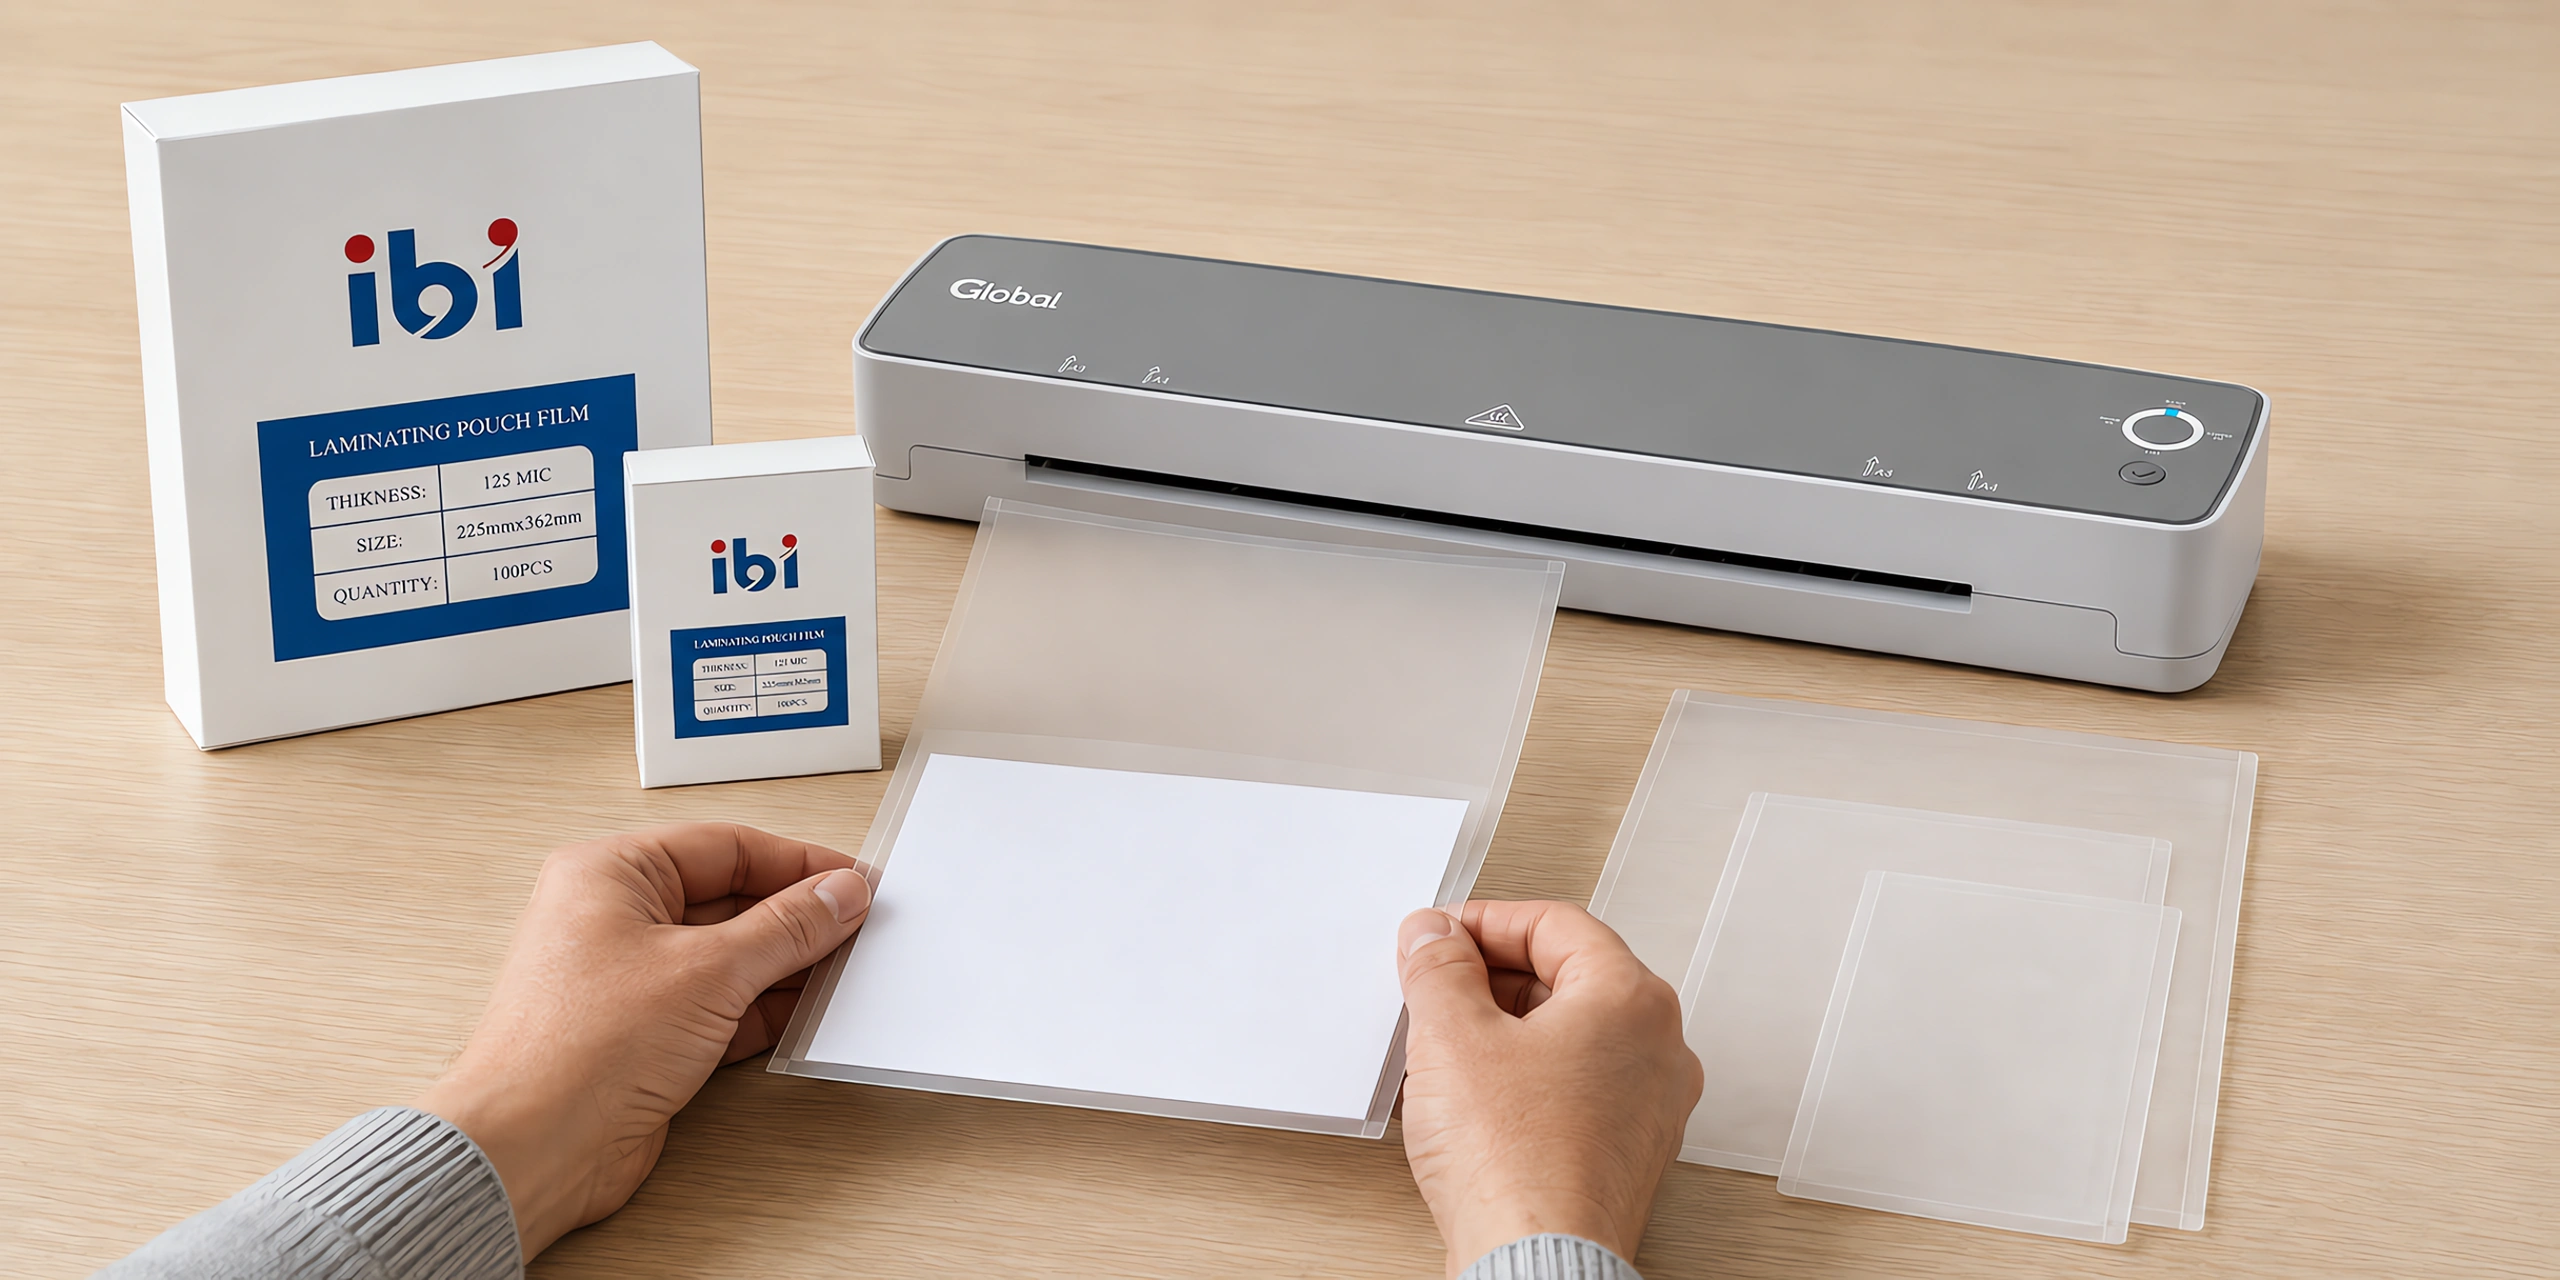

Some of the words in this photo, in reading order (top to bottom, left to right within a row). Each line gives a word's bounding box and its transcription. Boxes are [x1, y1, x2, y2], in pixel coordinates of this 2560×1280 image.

[344, 217, 523, 347] ibi
[949, 278, 1063, 309] Global
[309, 422, 451, 458] LAMINATING
[457, 412, 531, 438] POUCH
[537, 404, 589, 427] FILM
[485, 472, 511, 490] 125
[516, 467, 552, 486] MIC
[325, 485, 426, 511] THIKNESS:
[456, 512, 582, 540] 225mmx362mm
[356, 534, 402, 553] SIZE:
[493, 559, 553, 581] 100PCS
[711, 534, 799, 594] ibi
[333, 576, 438, 605] QUANTITY:
